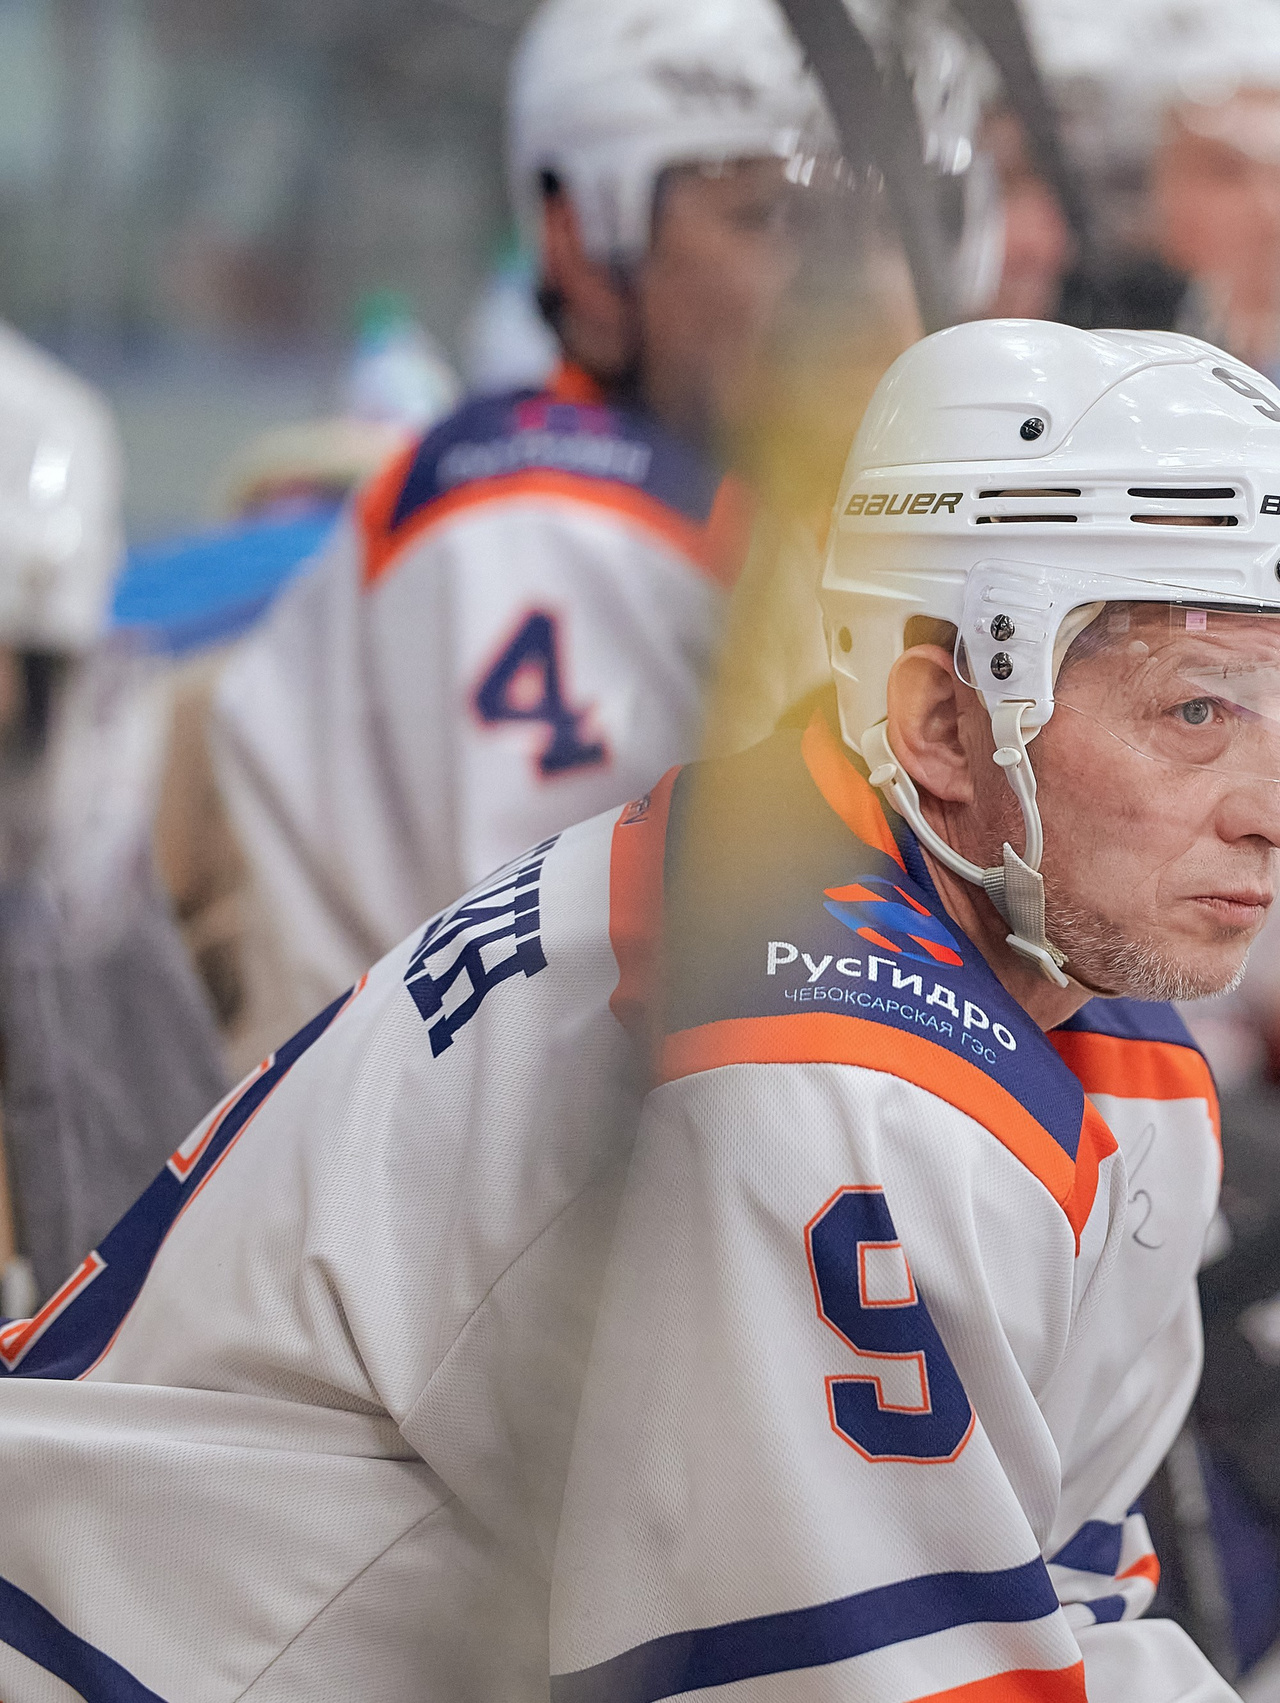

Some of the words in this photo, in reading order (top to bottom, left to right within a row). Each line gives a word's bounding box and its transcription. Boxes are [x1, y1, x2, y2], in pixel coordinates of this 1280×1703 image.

[470, 608, 610, 780] 4
[767, 941, 1017, 1051] РусГидро
[784, 986, 953, 1038] ЧЕБОКСАРСКАЯ
[961, 1032, 998, 1064] ГЭС
[803, 1184, 977, 1465] 9
